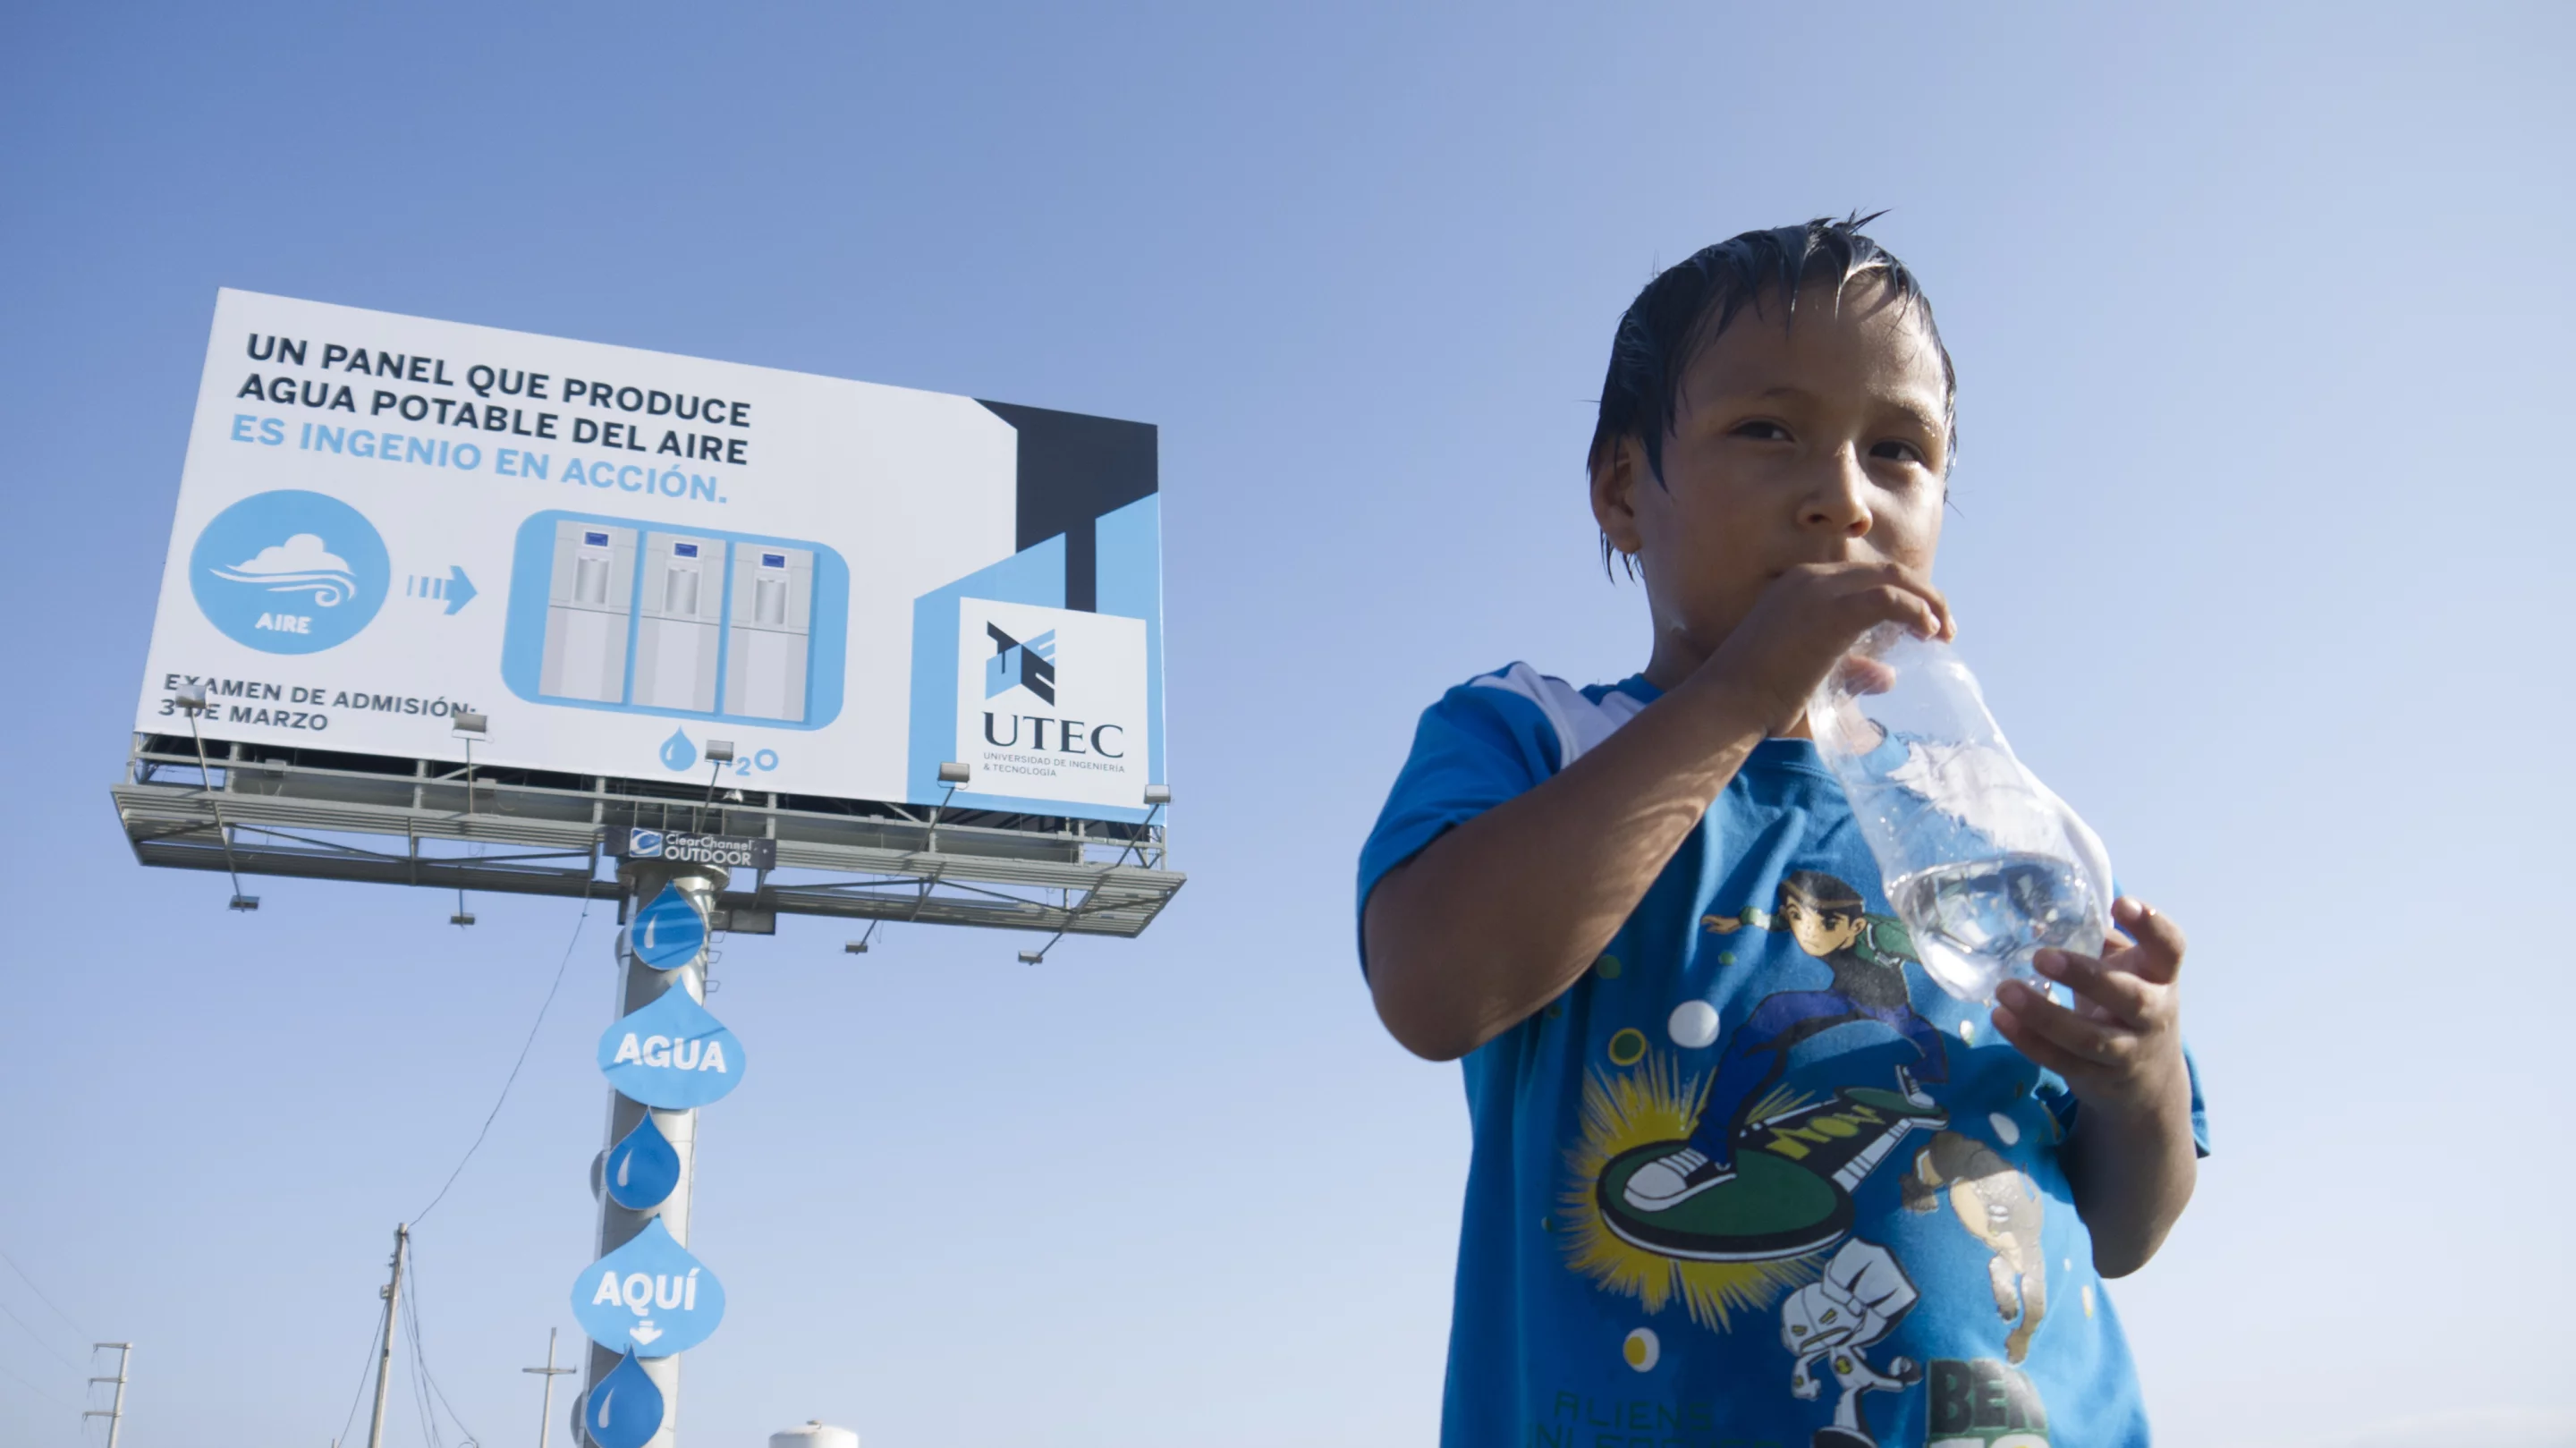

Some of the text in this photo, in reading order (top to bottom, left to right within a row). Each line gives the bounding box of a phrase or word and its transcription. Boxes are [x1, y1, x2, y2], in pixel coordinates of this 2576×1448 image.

[246, 333, 750, 428] UN PANEL QUE PRODUCE
[236, 373, 748, 465] AGUA POTABLE DEL AIRE
[230, 414, 727, 504] ES INGENIO EN ACCIÓN.
[255, 612, 311, 634] AIRE
[158, 699, 175, 716] 3
[229, 706, 328, 732] MARZO
[291, 687, 326, 706] DE
[982, 711, 1124, 758] UTEC
[983, 763, 1057, 777] & TECNOLOGÍA
[984, 752, 1125, 774] UNIVERSIDAD DE INGENIERÍA
[665, 846, 751, 866] OUTDOOR
[613, 1032, 727, 1074] AGUA
[591, 1266, 700, 1317] AQUÍ
[1554, 1391, 1712, 1431] ALIENS
